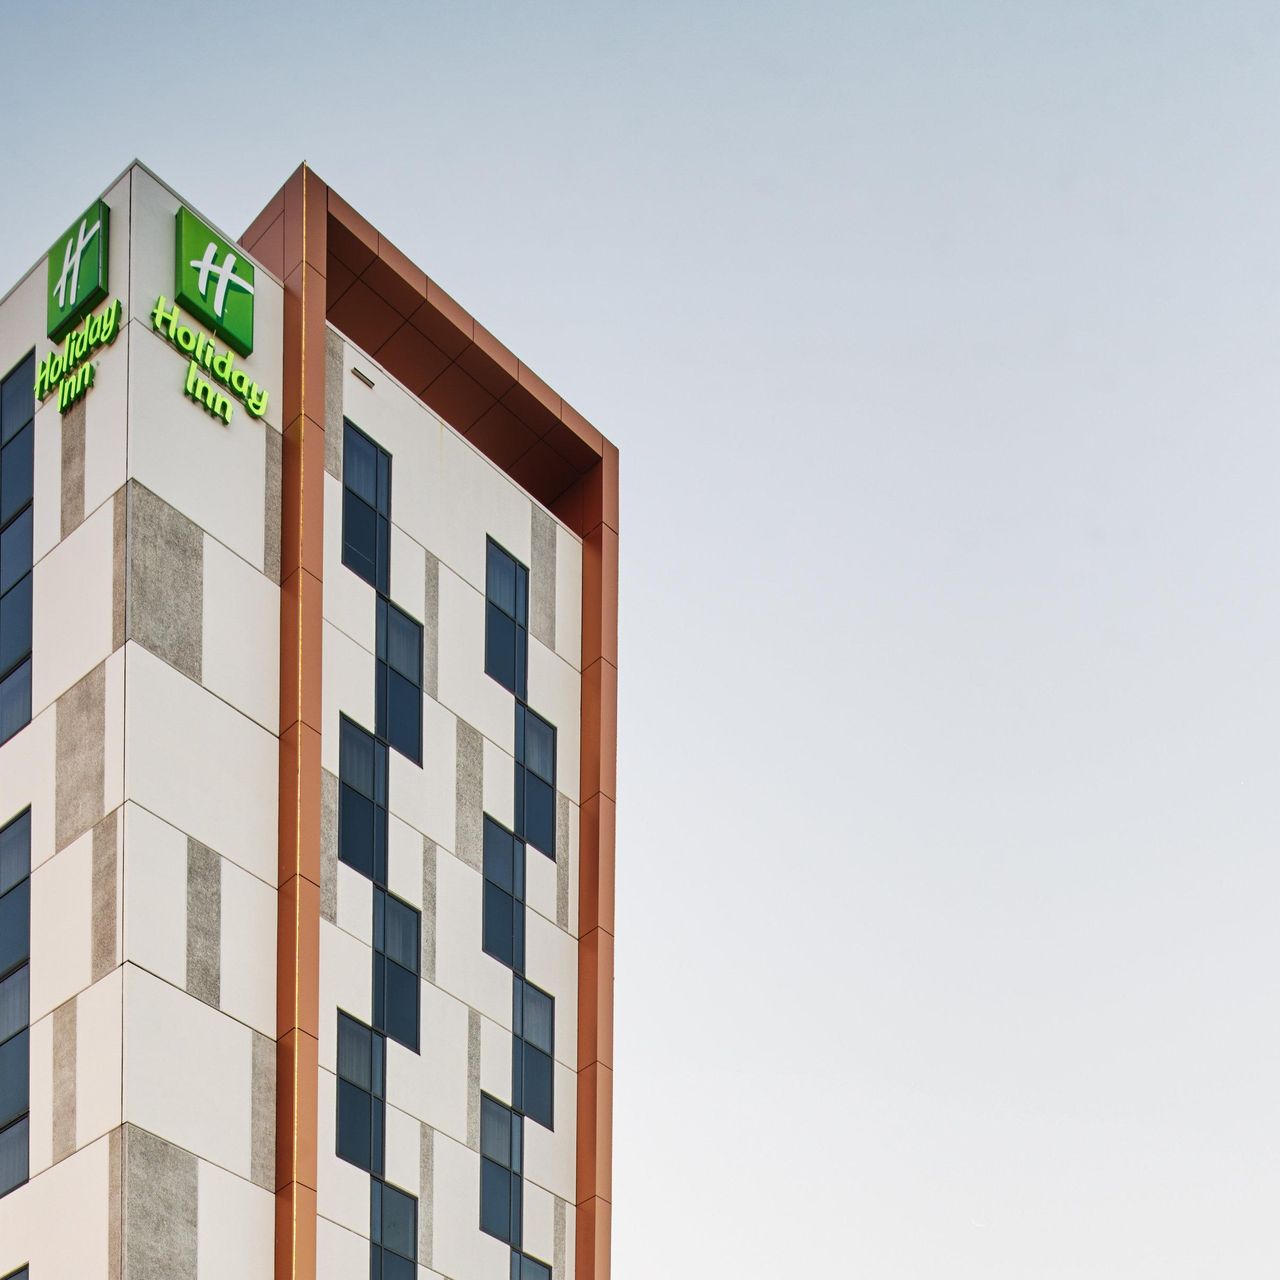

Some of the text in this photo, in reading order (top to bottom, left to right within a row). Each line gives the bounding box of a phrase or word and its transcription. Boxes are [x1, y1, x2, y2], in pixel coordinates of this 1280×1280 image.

[34, 299, 121, 402] Holiday
[58, 362, 95, 414] Inn
[152, 296, 269, 417] Holiday
[185, 361, 233, 424] Inn
